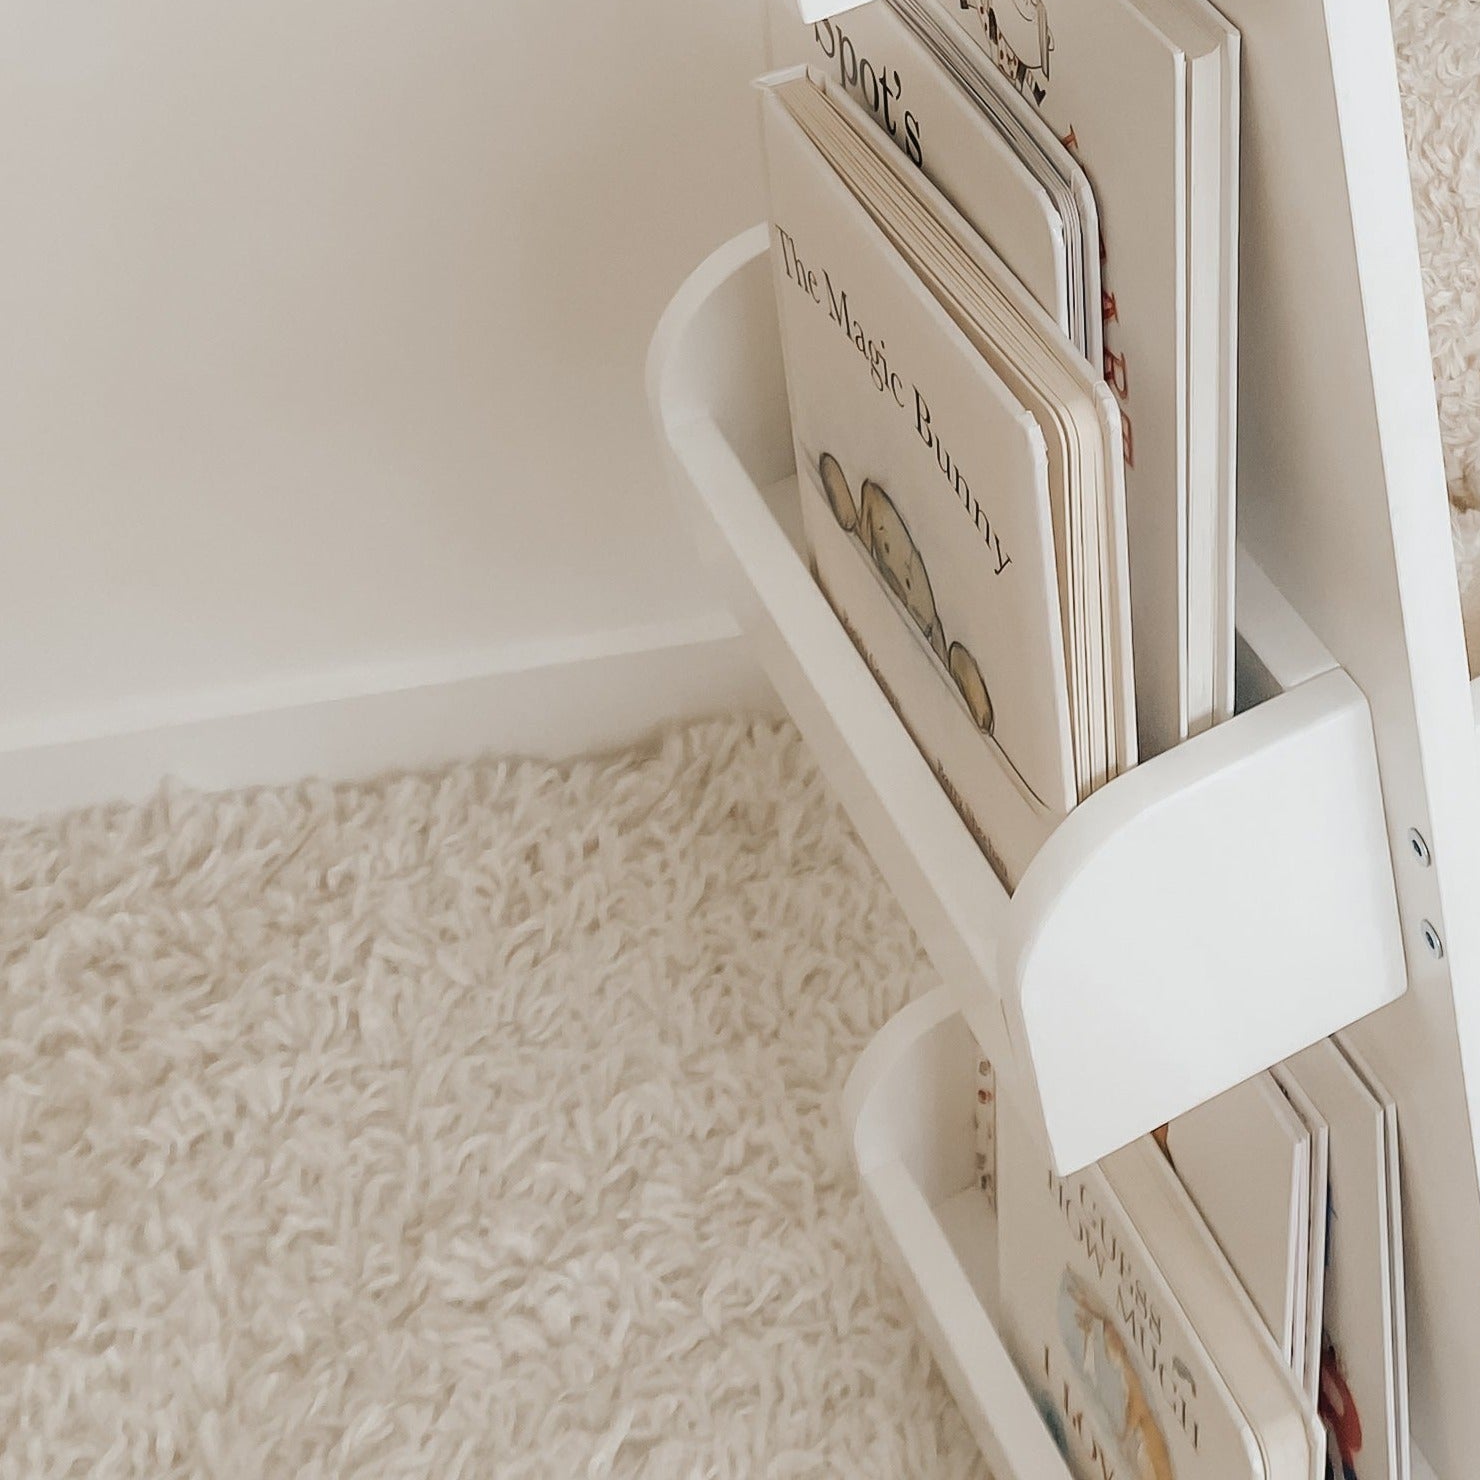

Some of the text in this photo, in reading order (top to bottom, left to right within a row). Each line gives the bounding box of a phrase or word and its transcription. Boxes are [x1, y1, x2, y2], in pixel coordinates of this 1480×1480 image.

[775, 221, 821, 305] The
[821, 267, 905, 409] Magic
[911, 382, 1013, 577] Bunny
